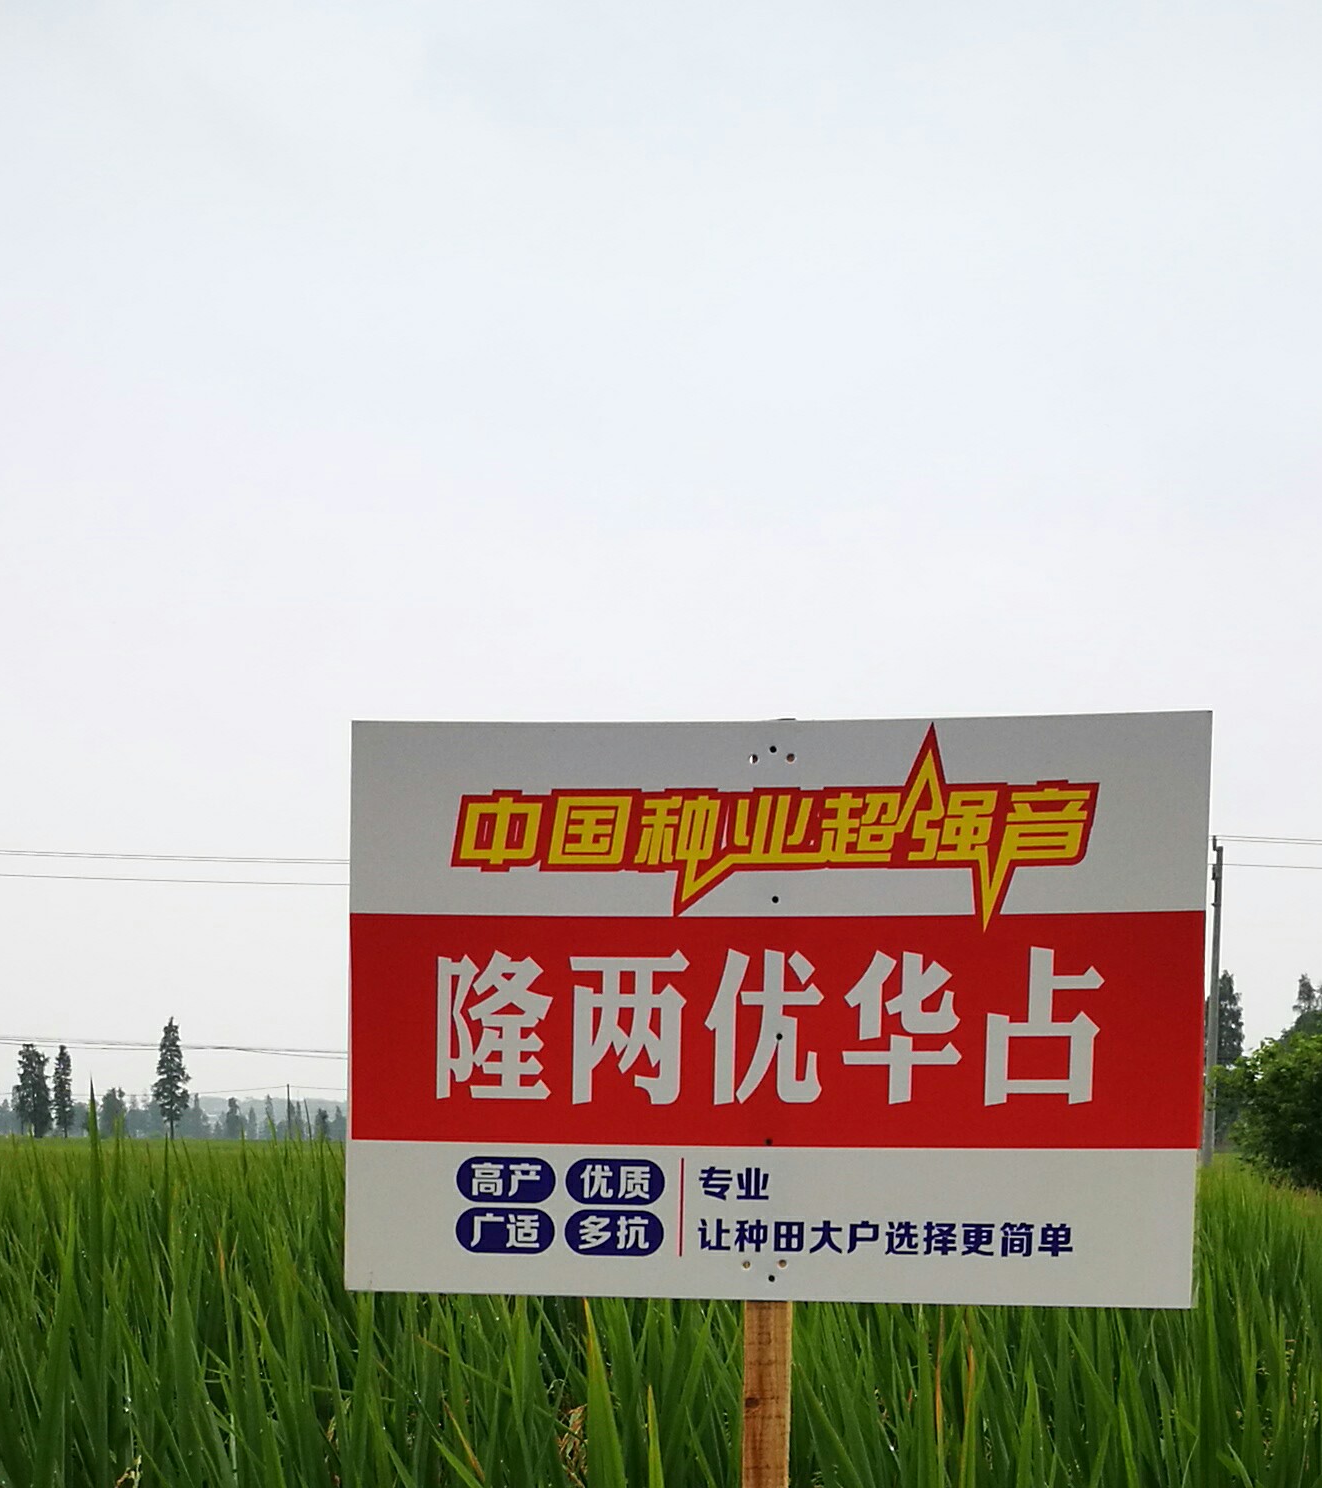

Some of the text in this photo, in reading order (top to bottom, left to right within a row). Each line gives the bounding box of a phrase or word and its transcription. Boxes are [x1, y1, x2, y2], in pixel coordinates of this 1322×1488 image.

[453, 752, 1099, 918] 中国种业超强音
[435, 946, 1105, 1108] 隆两优华占
[470, 1163, 652, 1200] 高产 优质
[698, 1166, 770, 1201] 专业
[470, 1213, 650, 1250] 广适 多抗
[697, 1217, 1074, 1258] 让种田大户选择更简单
